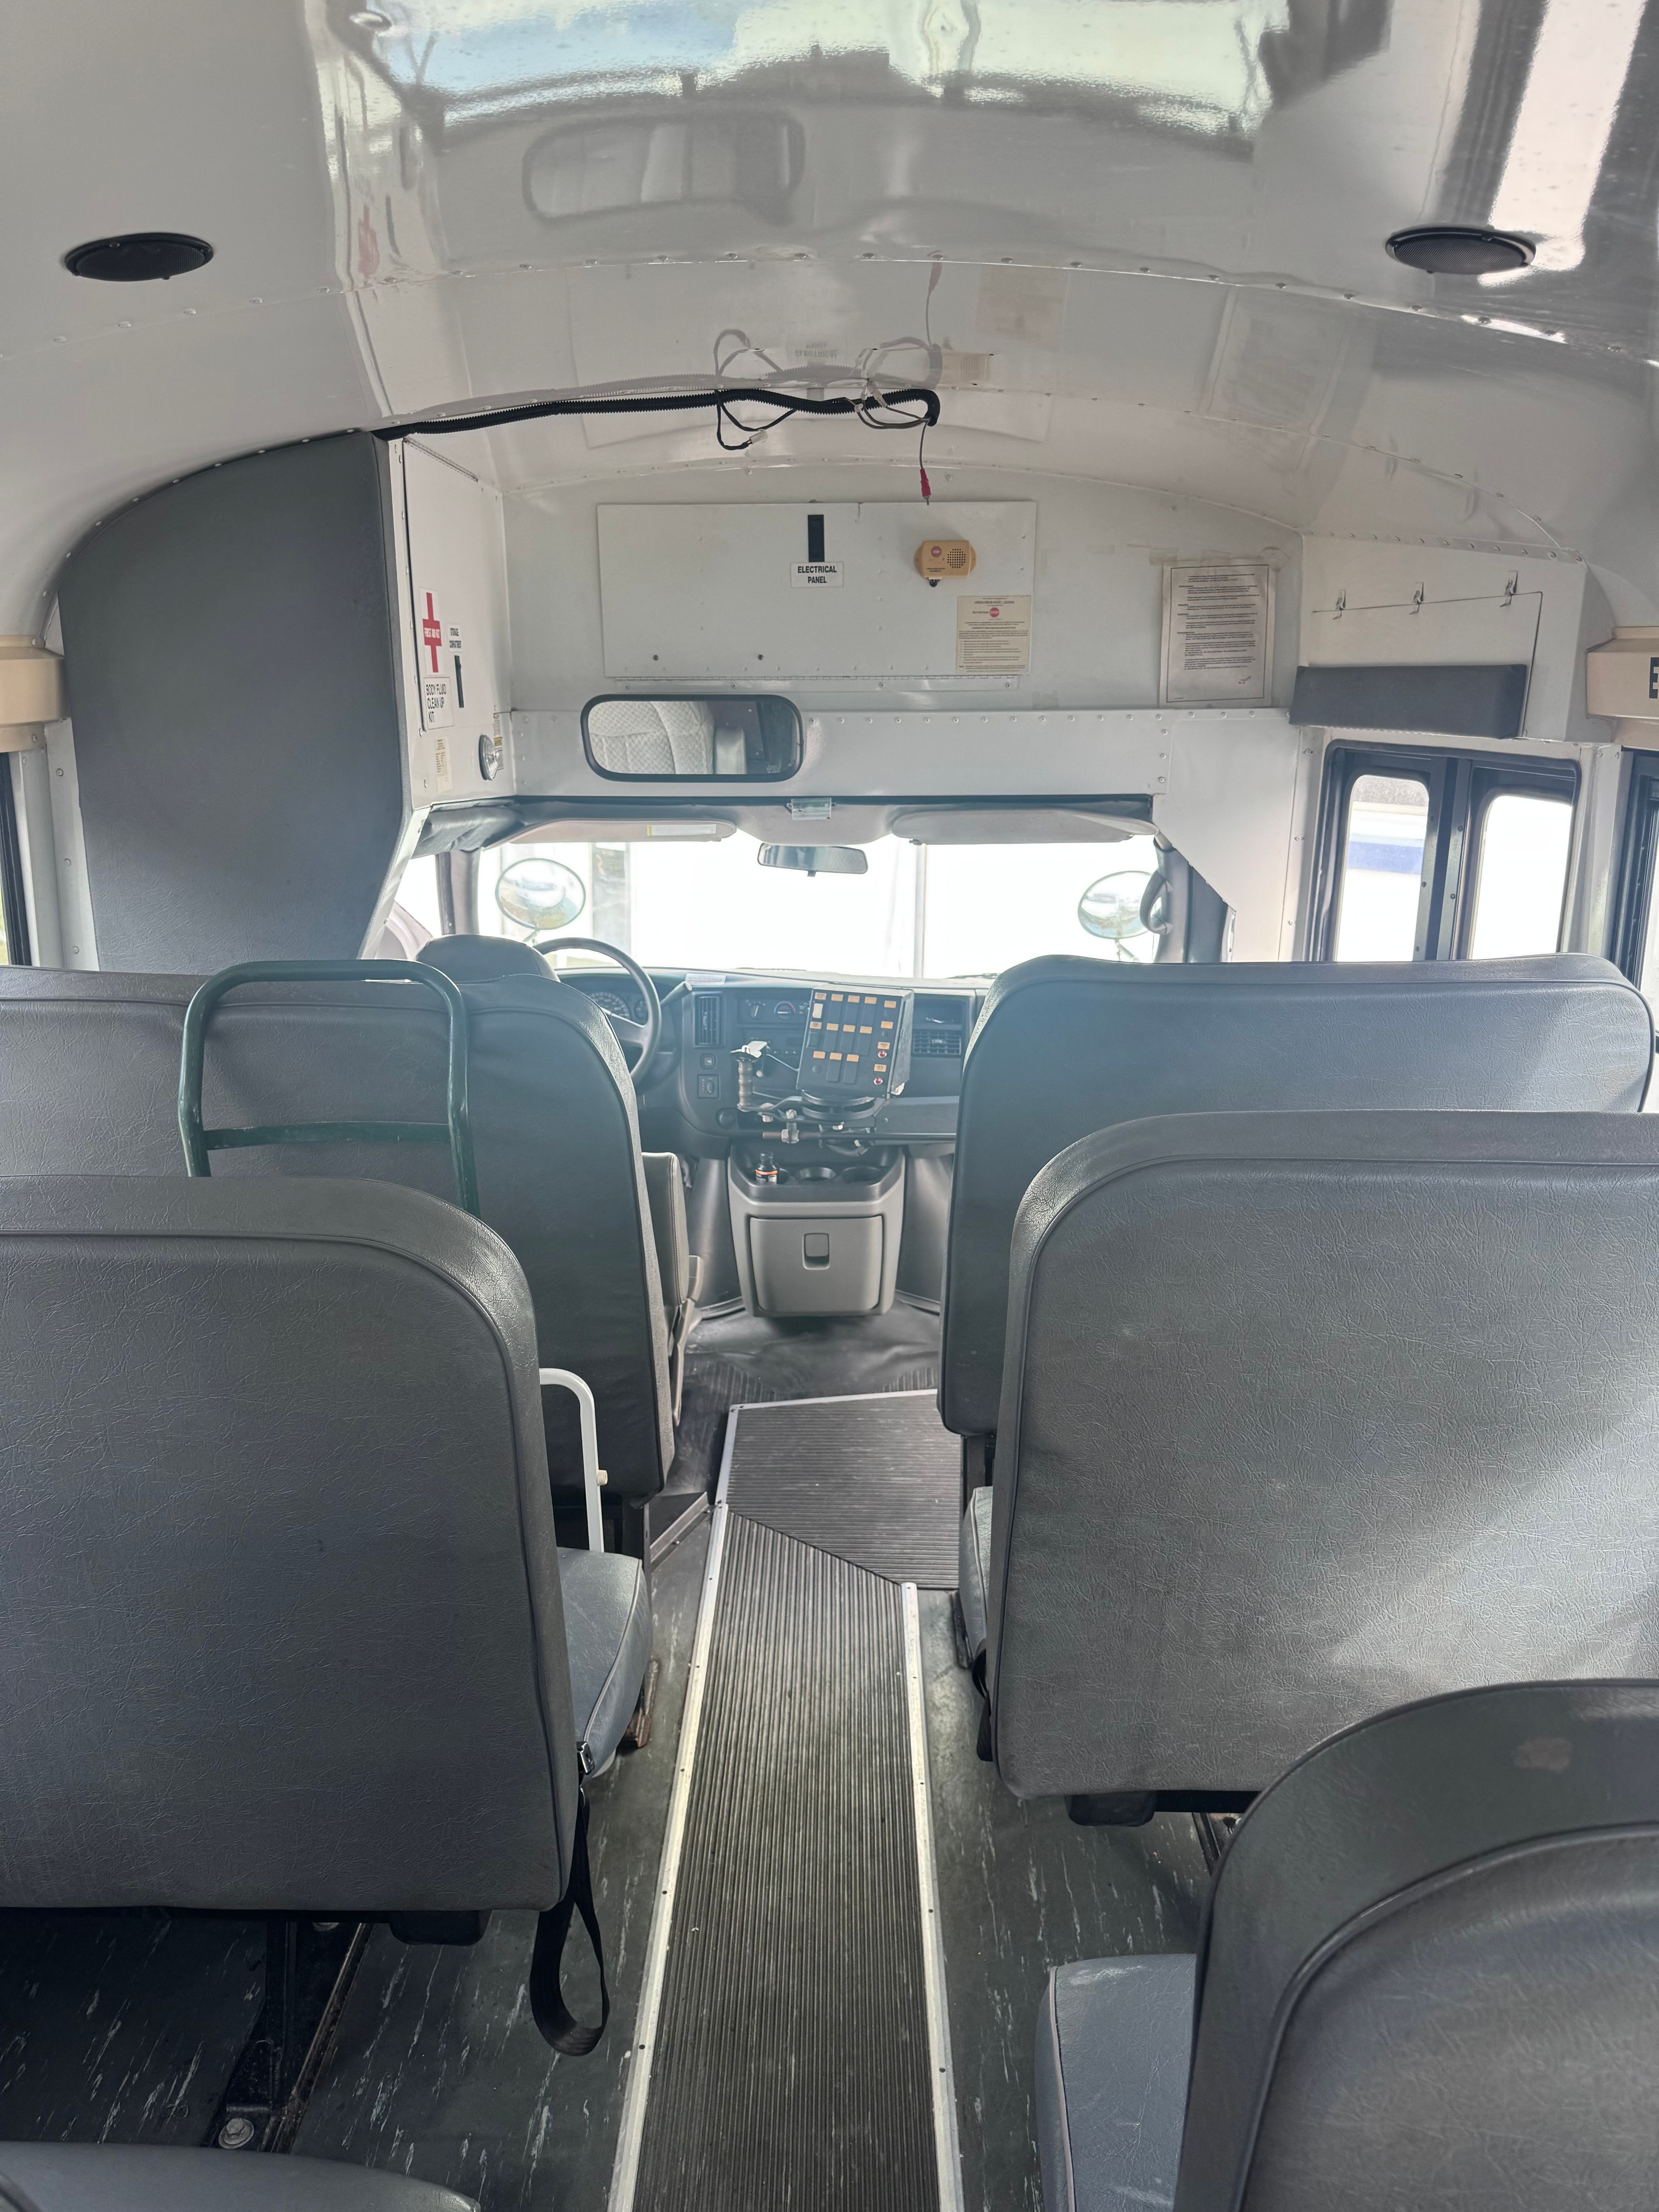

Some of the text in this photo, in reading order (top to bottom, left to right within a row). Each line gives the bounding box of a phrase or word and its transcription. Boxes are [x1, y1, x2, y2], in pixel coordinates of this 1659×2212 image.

[426, 684, 446, 695] BODY FLUID
[428, 697, 444, 709] CLEAN UP
